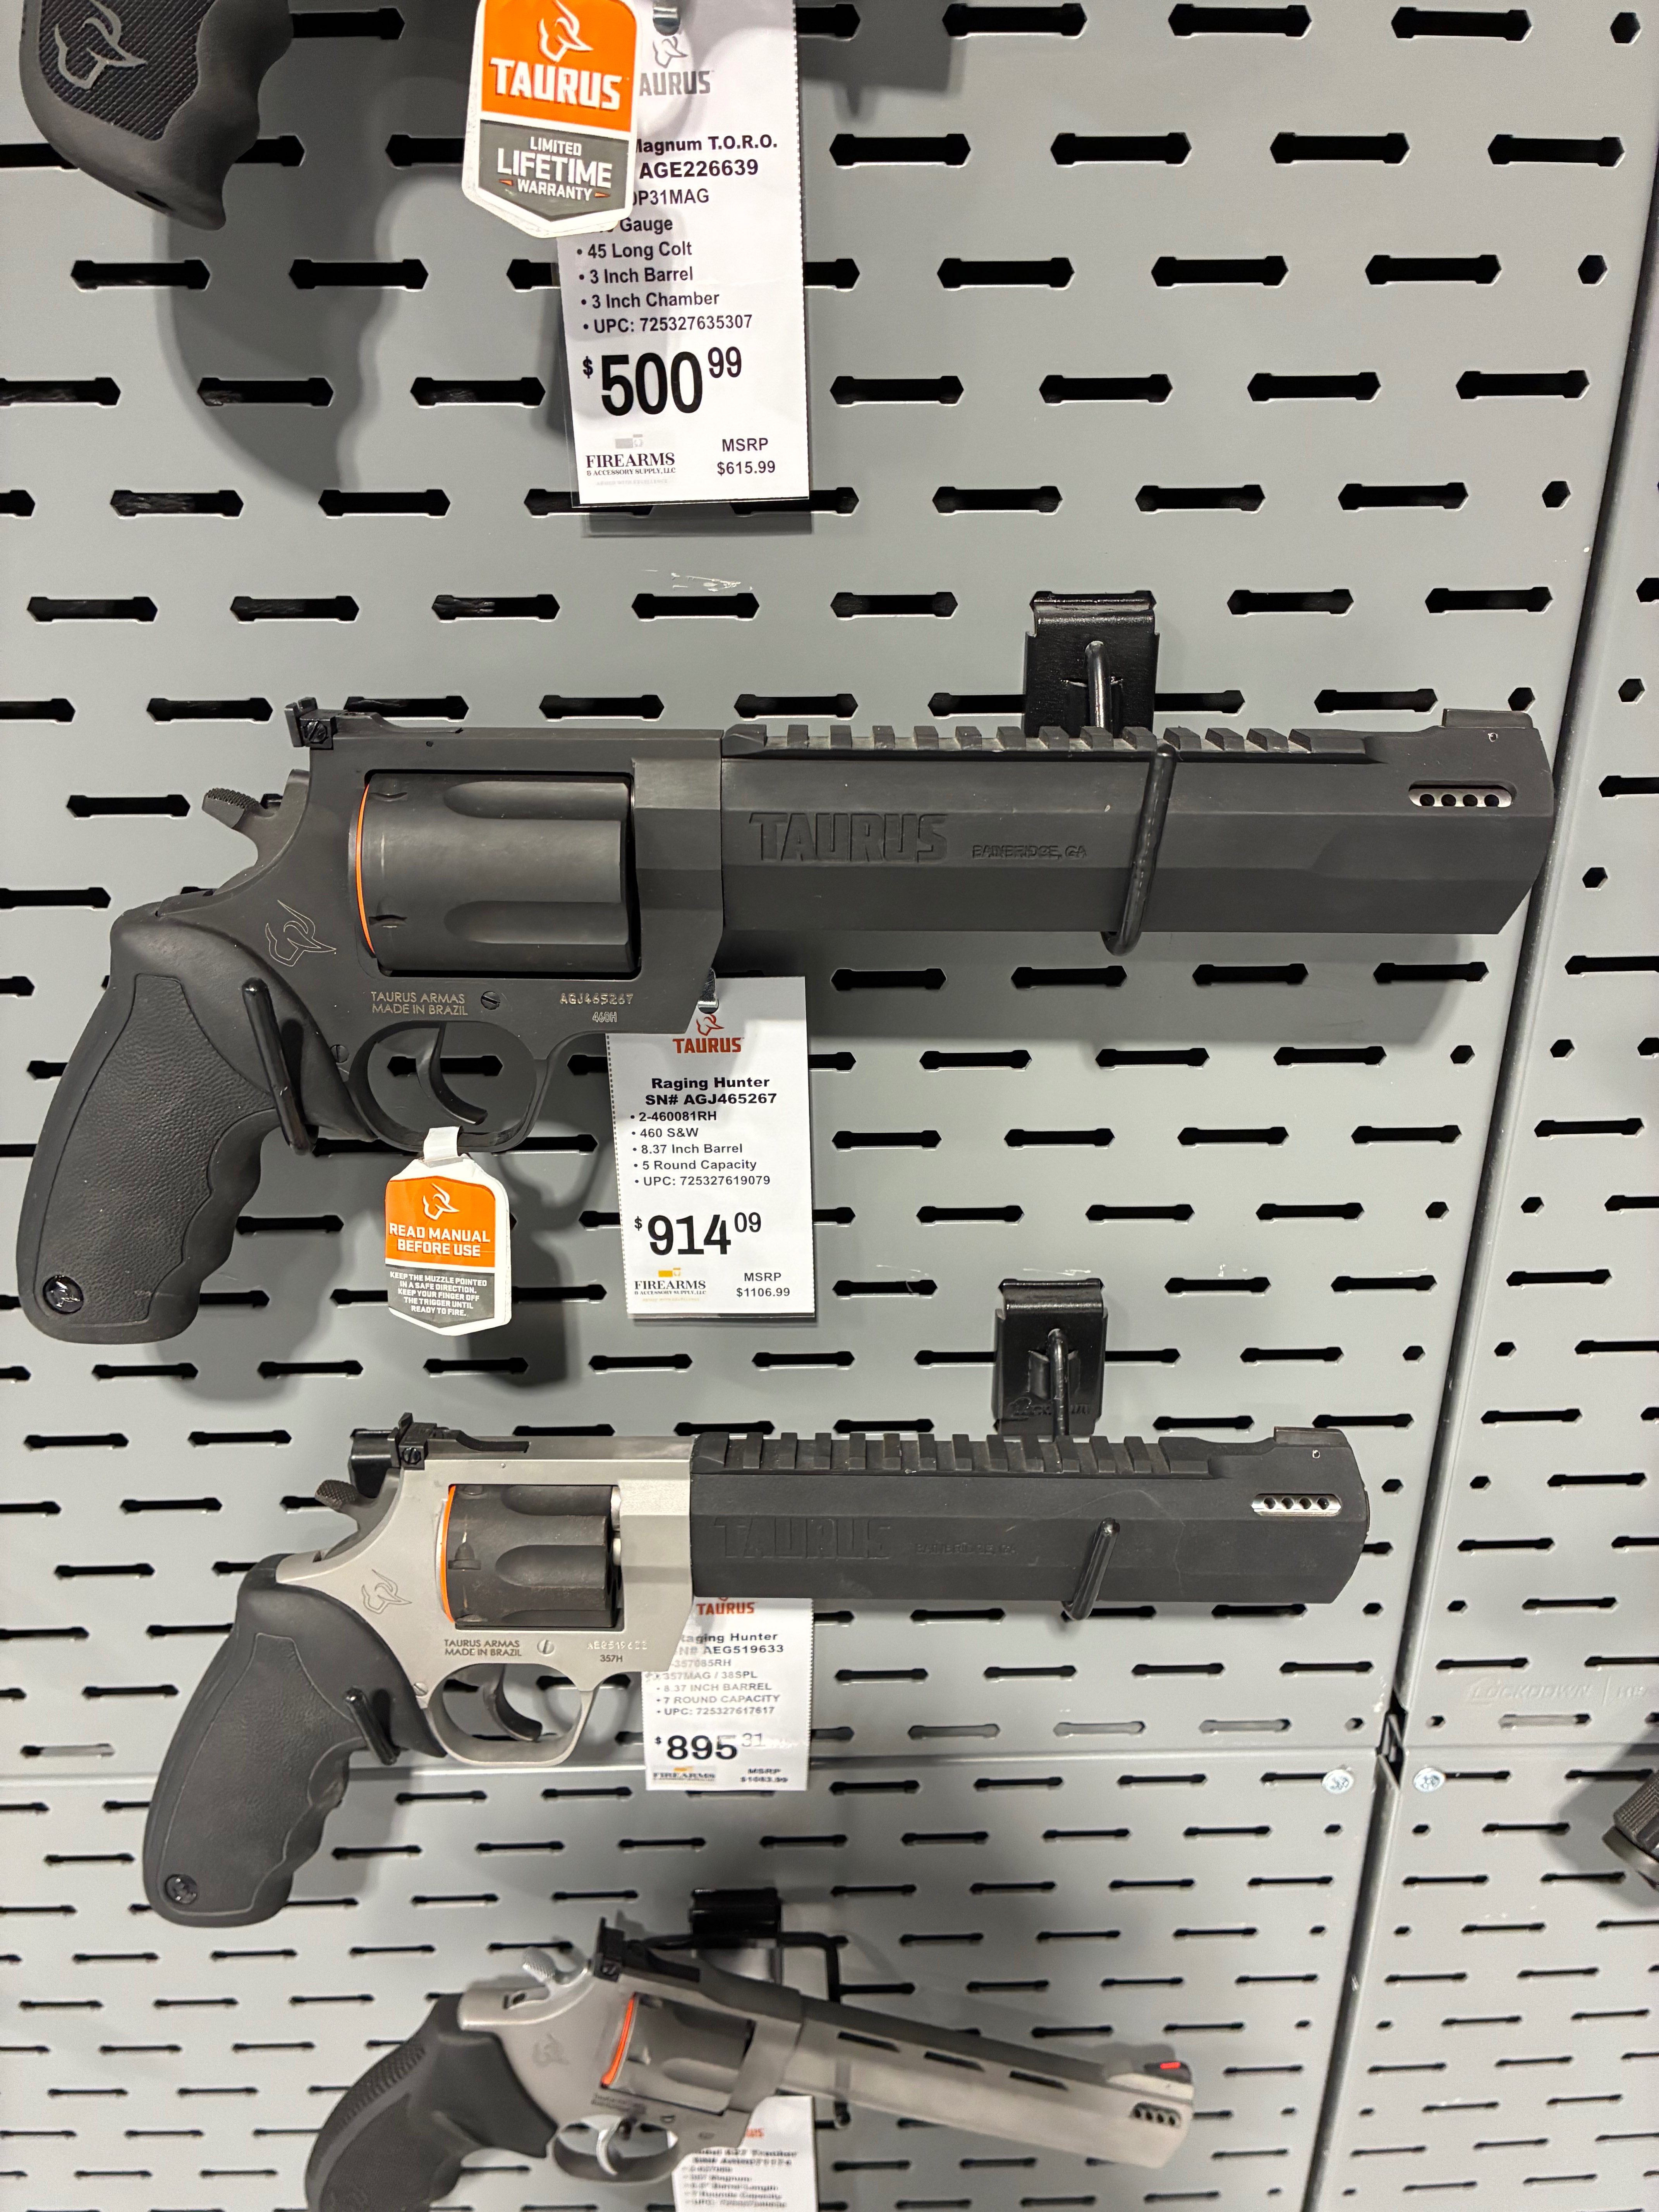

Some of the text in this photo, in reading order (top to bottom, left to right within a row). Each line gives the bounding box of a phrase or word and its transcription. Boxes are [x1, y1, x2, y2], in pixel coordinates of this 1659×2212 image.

[490, 57, 622, 110] TAURUS
[639, 70, 711, 96] AURUS
[530, 136, 582, 156] LIMITED
[708, 134, 777, 150] T.O.R.O.
[497, 148, 612, 189] LIFETIME
[639, 159, 759, 179] AGE226639
[517, 178, 592, 201] WARRANTY
[620, 217, 673, 235] Gauge
[588, 241, 692, 261] 45 Long Colt
[590, 266, 693, 284] 3 Inch Barrel
[592, 292, 720, 309] 3 Inch Chamber
[594, 314, 752, 333] UPC: 725327635307
[582, 346, 742, 416] $ 500 99
[721, 437, 769, 452] MSRP
[585, 452, 675, 468] FIREARMS
[716, 460, 776, 476] $615.99
[750, 813, 948, 863] TAURUS
[371, 991, 465, 1004] TAURUS ARMAS
[559, 993, 634, 1005] AGJ465267
[372, 1003, 468, 1016] MADE IN BRAZIL
[592, 1012, 617, 1023] 460H
[672, 1037, 742, 1054] TAURUS
[651, 1077, 770, 1091] Raging Hunter
[645, 1093, 777, 1106] SN# AGJ465267
[639, 1111, 717, 1122] 2-460081RH
[640, 1127, 699, 1138] 460 S&W
[641, 1143, 742, 1154] 8.37 Inch Barrel
[642, 1159, 757, 1172] 5 Round Capacity
[643, 1175, 771, 1186] UPC: 725327619079
[389, 1222, 491, 1243] READ MANUAL
[634, 1212, 762, 1255] $ 914 09
[397, 1239, 481, 1257] BEFORE USE
[390, 1271, 408, 1280] KEEP
[424, 1275, 454, 1284] MUZZLE
[455, 1278, 487, 1287] POINTED
[744, 1272, 782, 1282] MSRP
[435, 1284, 477, 1294] DIRECTION.
[634, 1280, 706, 1290] FIREARMS
[398, 1288, 416, 1297] KEEP
[438, 1292, 465, 1301] FINGER
[736, 1288, 790, 1297] $1106.99
[404, 1296, 474, 1309] THE TRIGGER UNTIL
[411, 1305, 436, 1314] READY
[447, 1309, 467, 1317] FIRE.
[696, 1602, 755, 1616] TAURUS
[444, 1639, 520, 1648] TAURUS ARMAS
[730, 1633, 778, 1642] Hunter
[445, 1648, 522, 1657] MADE IN BRAZIL
[703, 1645, 784, 1654] AEG519633
[600, 1654, 623, 1662] 357H
[721, 1671, 757, 1679] 38SPL
[690, 1684, 719, 1692] INCH
[722, 1683, 773, 1691] BARREL
[673, 1695, 717, 1704] ROUND
[720, 1694, 781, 1703] CAPACITY
[664, 1707, 693, 1716] UPC:
[654, 1736, 662, 1745] $
[667, 1735, 737, 1760] 895
